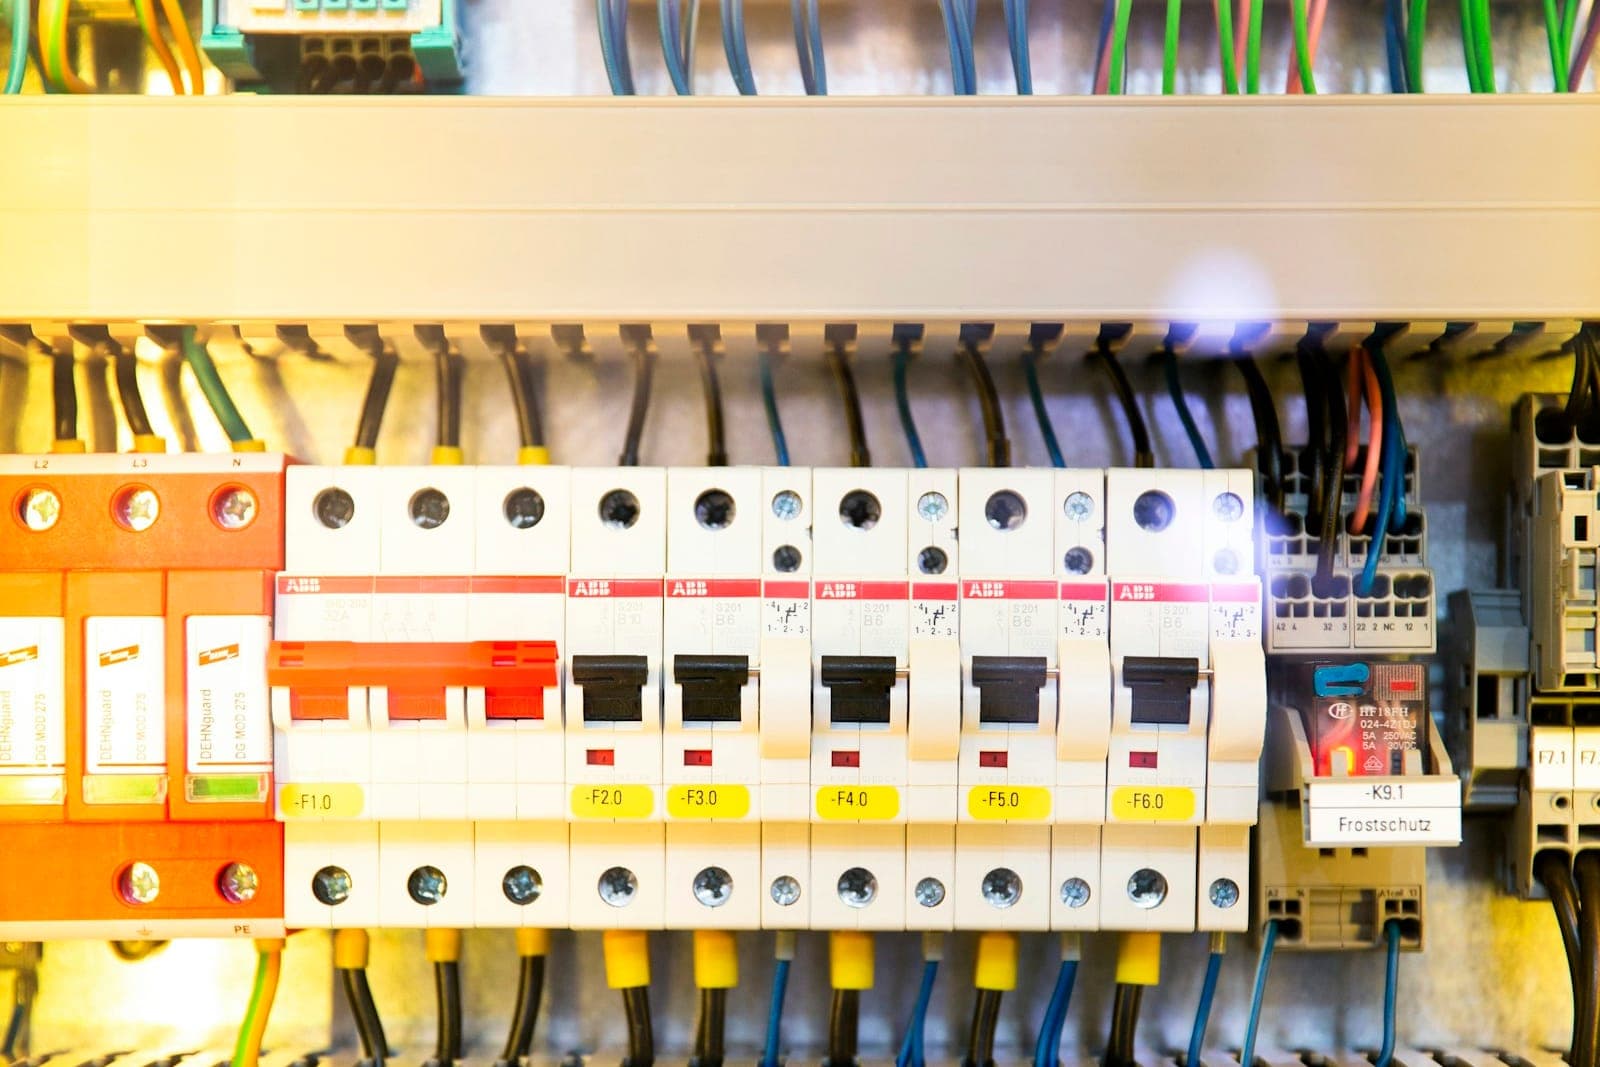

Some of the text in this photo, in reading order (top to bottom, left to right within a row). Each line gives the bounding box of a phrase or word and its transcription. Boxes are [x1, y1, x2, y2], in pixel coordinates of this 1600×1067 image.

[34, 460, 49, 469] L2
[133, 459, 148, 468] L3
[232, 458, 241, 467] N
[286, 578, 320, 593] ABB
[575, 581, 610, 596] ABB
[672, 581, 708, 596] ABB
[821, 583, 857, 598] ABB
[969, 583, 1004, 597] ABB
[1119, 585, 1155, 600] ABB
[1276, 622, 1348, 632] 42 4 32 3
[1356, 622, 1366, 632] 22
[1373, 622, 1378, 632] 2
[1383, 622, 1395, 632] NC
[1405, 622, 1413, 632] 12
[1360, 706, 1409, 717] HF18FH
[1362, 732, 1416, 740] 5A 250VAC
[1362, 742, 1416, 750] 5A 30VDC
[1539, 750, 1565, 765] F7.1
[586, 789, 622, 805] -F2.0
[681, 789, 717, 805] -F3.0
[831, 791, 868, 807] -F4.0
[982, 791, 1019, 807] -F5.0
[1366, 785, 1404, 801] -K9.1
[294, 794, 331, 810] -F1.0
[1127, 793, 1164, 809] -F6.0
[1339, 817, 1432, 832] Frostschutz
[1267, 889, 1279, 897] A2
[234, 925, 250, 934] PE
